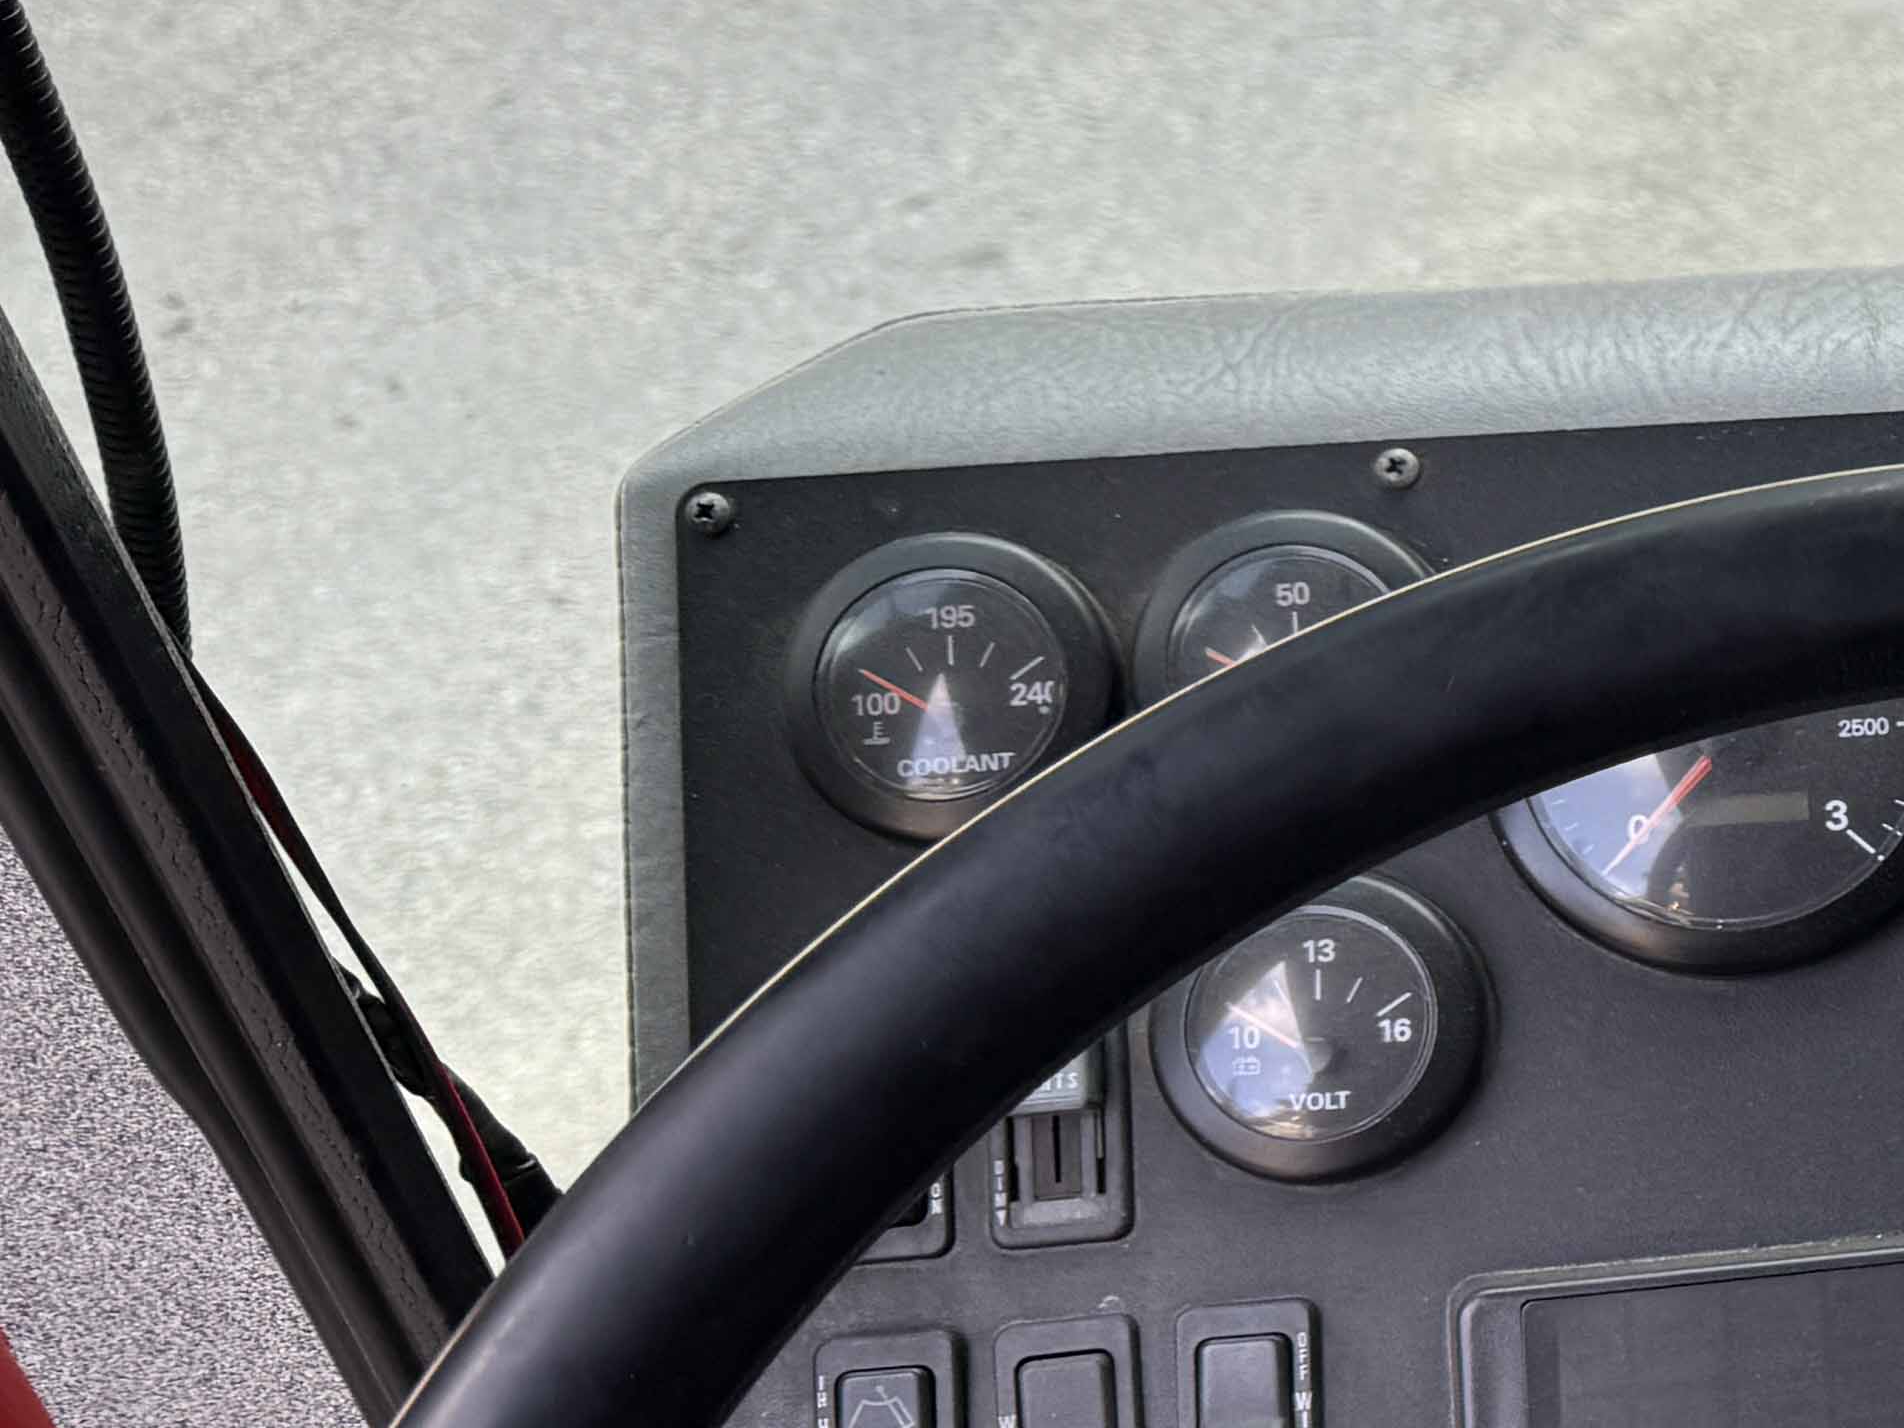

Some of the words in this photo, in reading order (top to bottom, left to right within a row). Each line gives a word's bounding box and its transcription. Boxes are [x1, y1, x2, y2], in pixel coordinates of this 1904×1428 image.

[1275, 582, 1311, 607] 50
[926, 605, 976, 629] 195
[851, 692, 901, 717] 100
[1838, 716, 1890, 738] 2500
[896, 752, 1015, 777] COOLANT
[1824, 800, 1849, 832] 3
[1303, 938, 1336, 963] 13
[1228, 1026, 1261, 1050] 10
[1377, 1018, 1412, 1043] 16
[1288, 1090, 1352, 1111] VOLT
[1297, 1331, 1311, 1381] OFF
